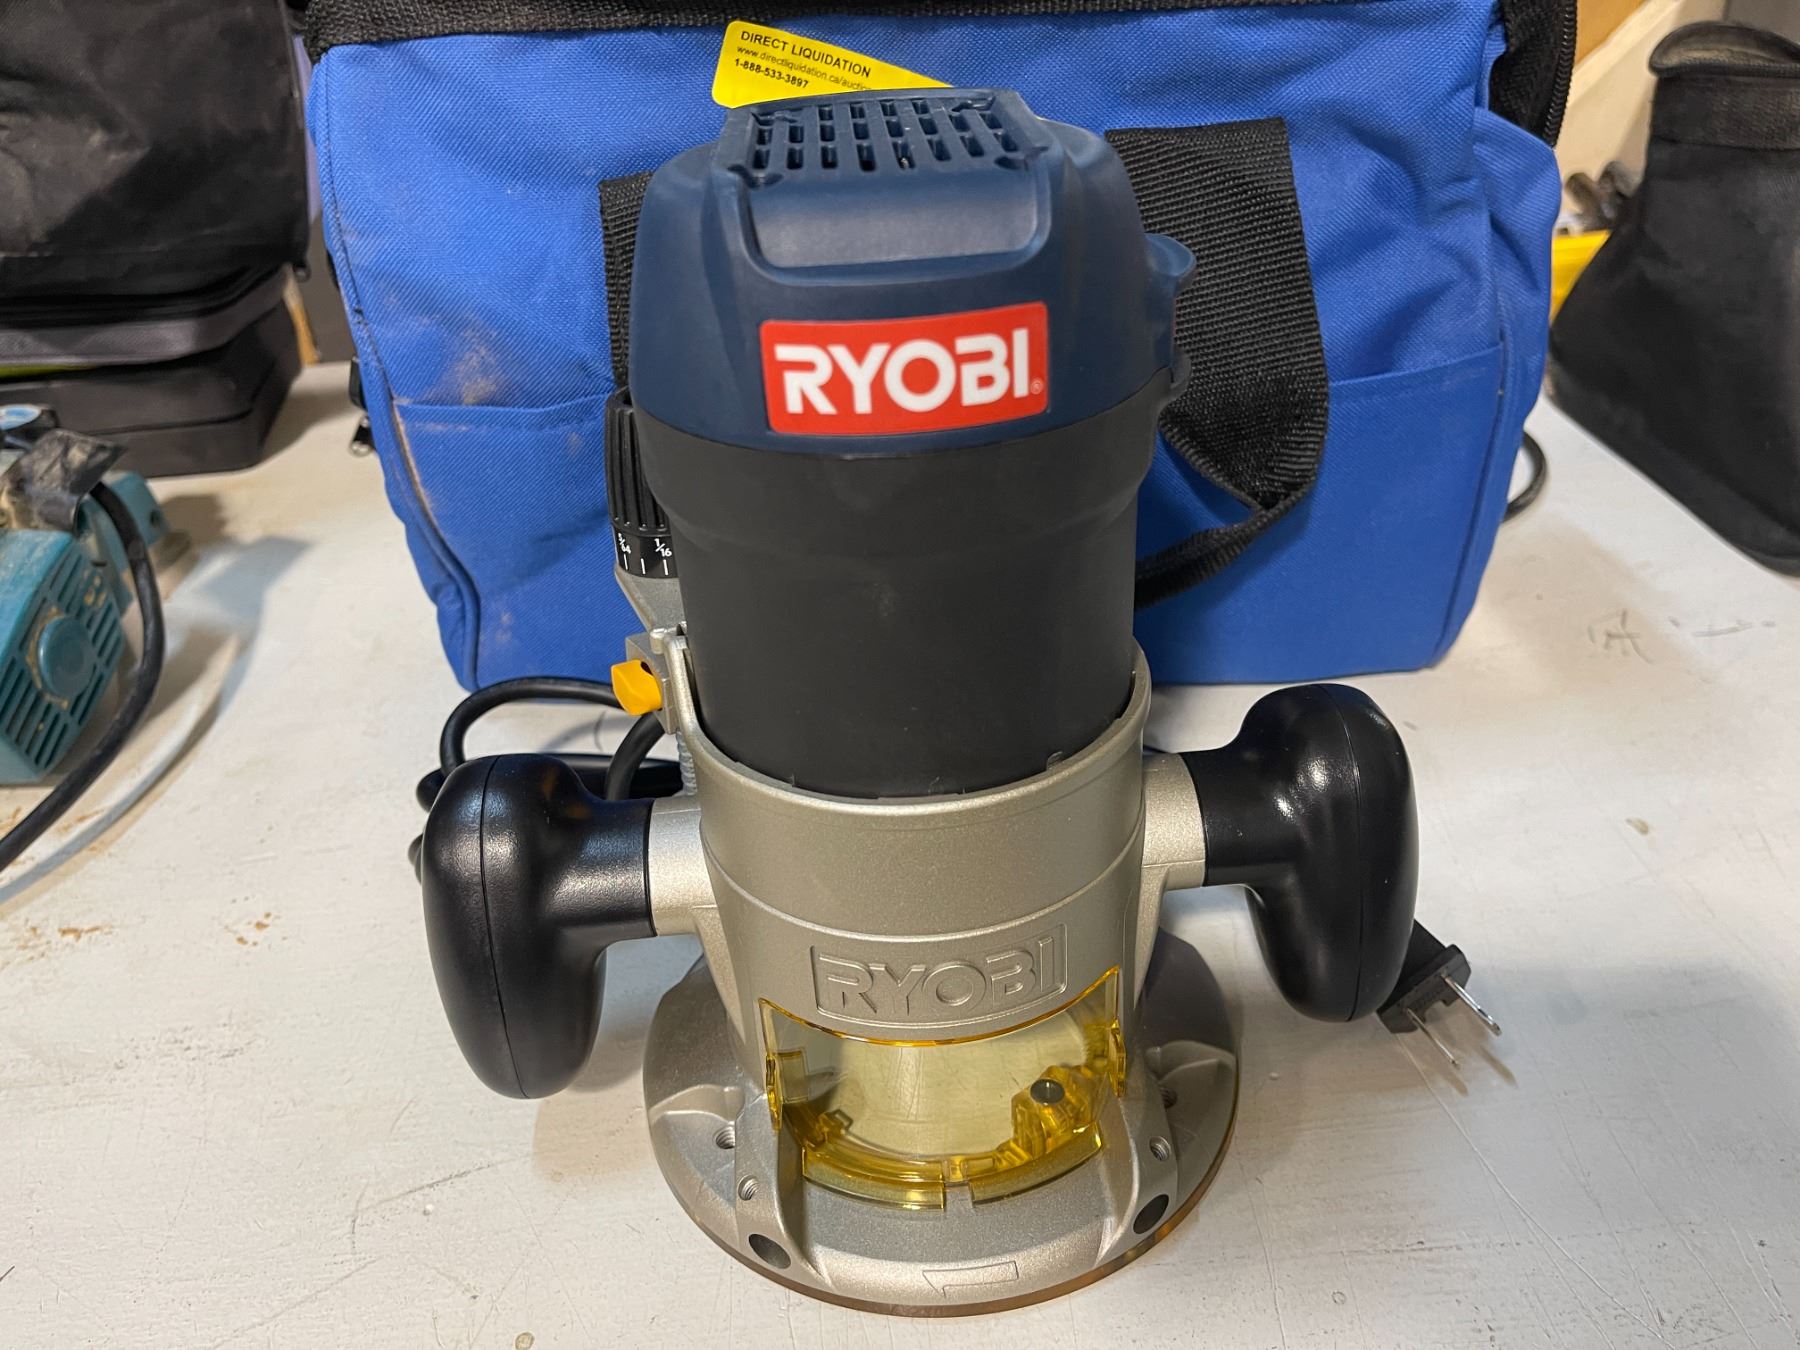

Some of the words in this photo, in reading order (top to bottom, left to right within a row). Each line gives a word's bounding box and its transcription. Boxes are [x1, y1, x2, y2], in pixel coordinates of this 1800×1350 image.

[735, 58, 809, 88] 1-888-533-3897
[741, 31, 789, 52] DIRECT
[791, 44, 872, 78] LIQUIDATION
[774, 327, 1029, 415] RYOBI
[654, 538, 672, 557] 1/16
[818, 936, 1056, 1017] RYOBI
